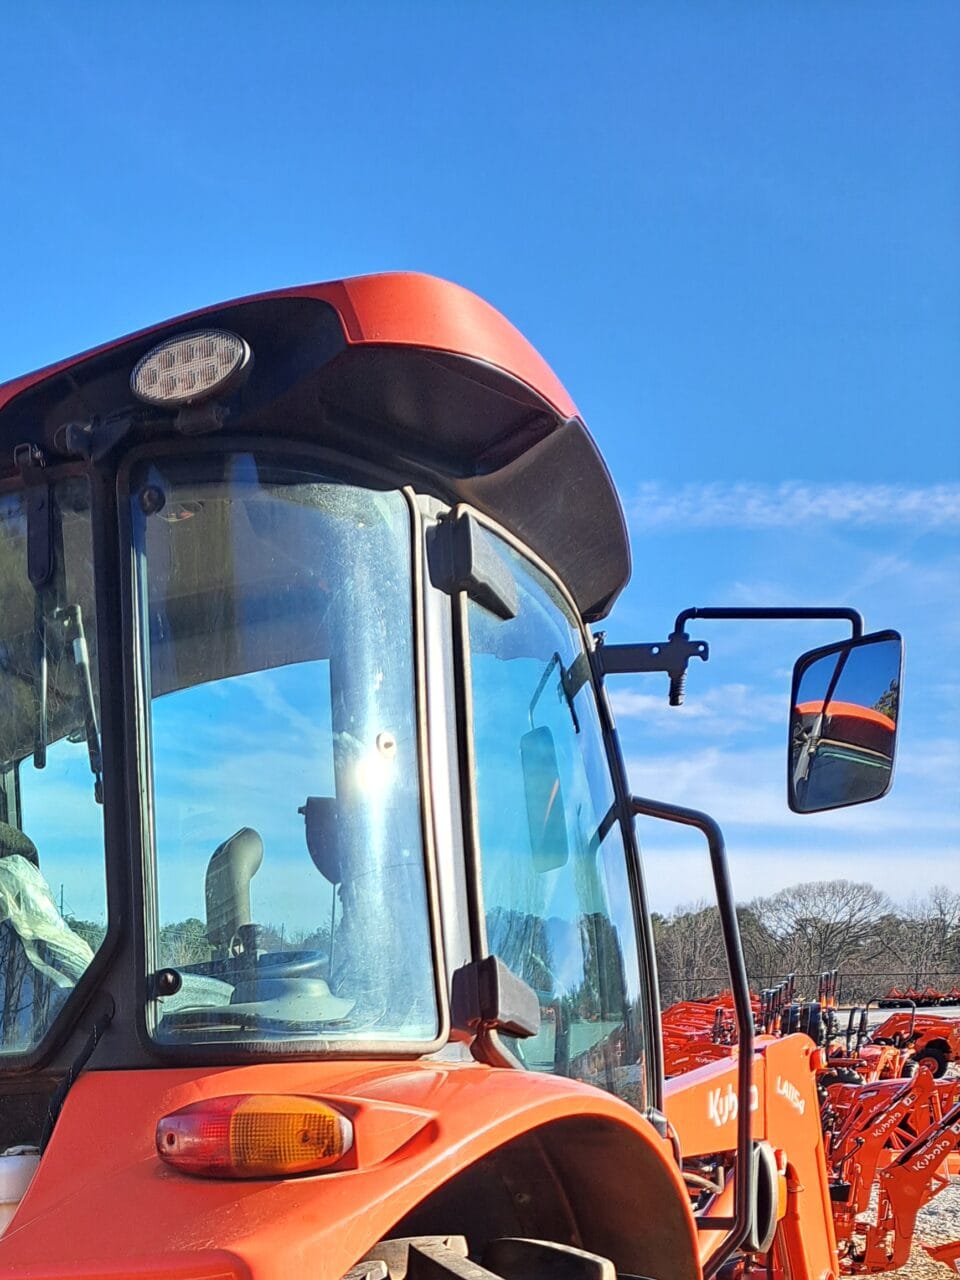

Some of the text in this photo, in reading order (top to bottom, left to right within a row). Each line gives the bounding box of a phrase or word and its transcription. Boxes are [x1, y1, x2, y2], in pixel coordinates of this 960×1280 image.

[708, 1082, 759, 1127] Kuba
[872, 1112, 901, 1137] Kubota
[912, 1140, 950, 1171] Kubota
